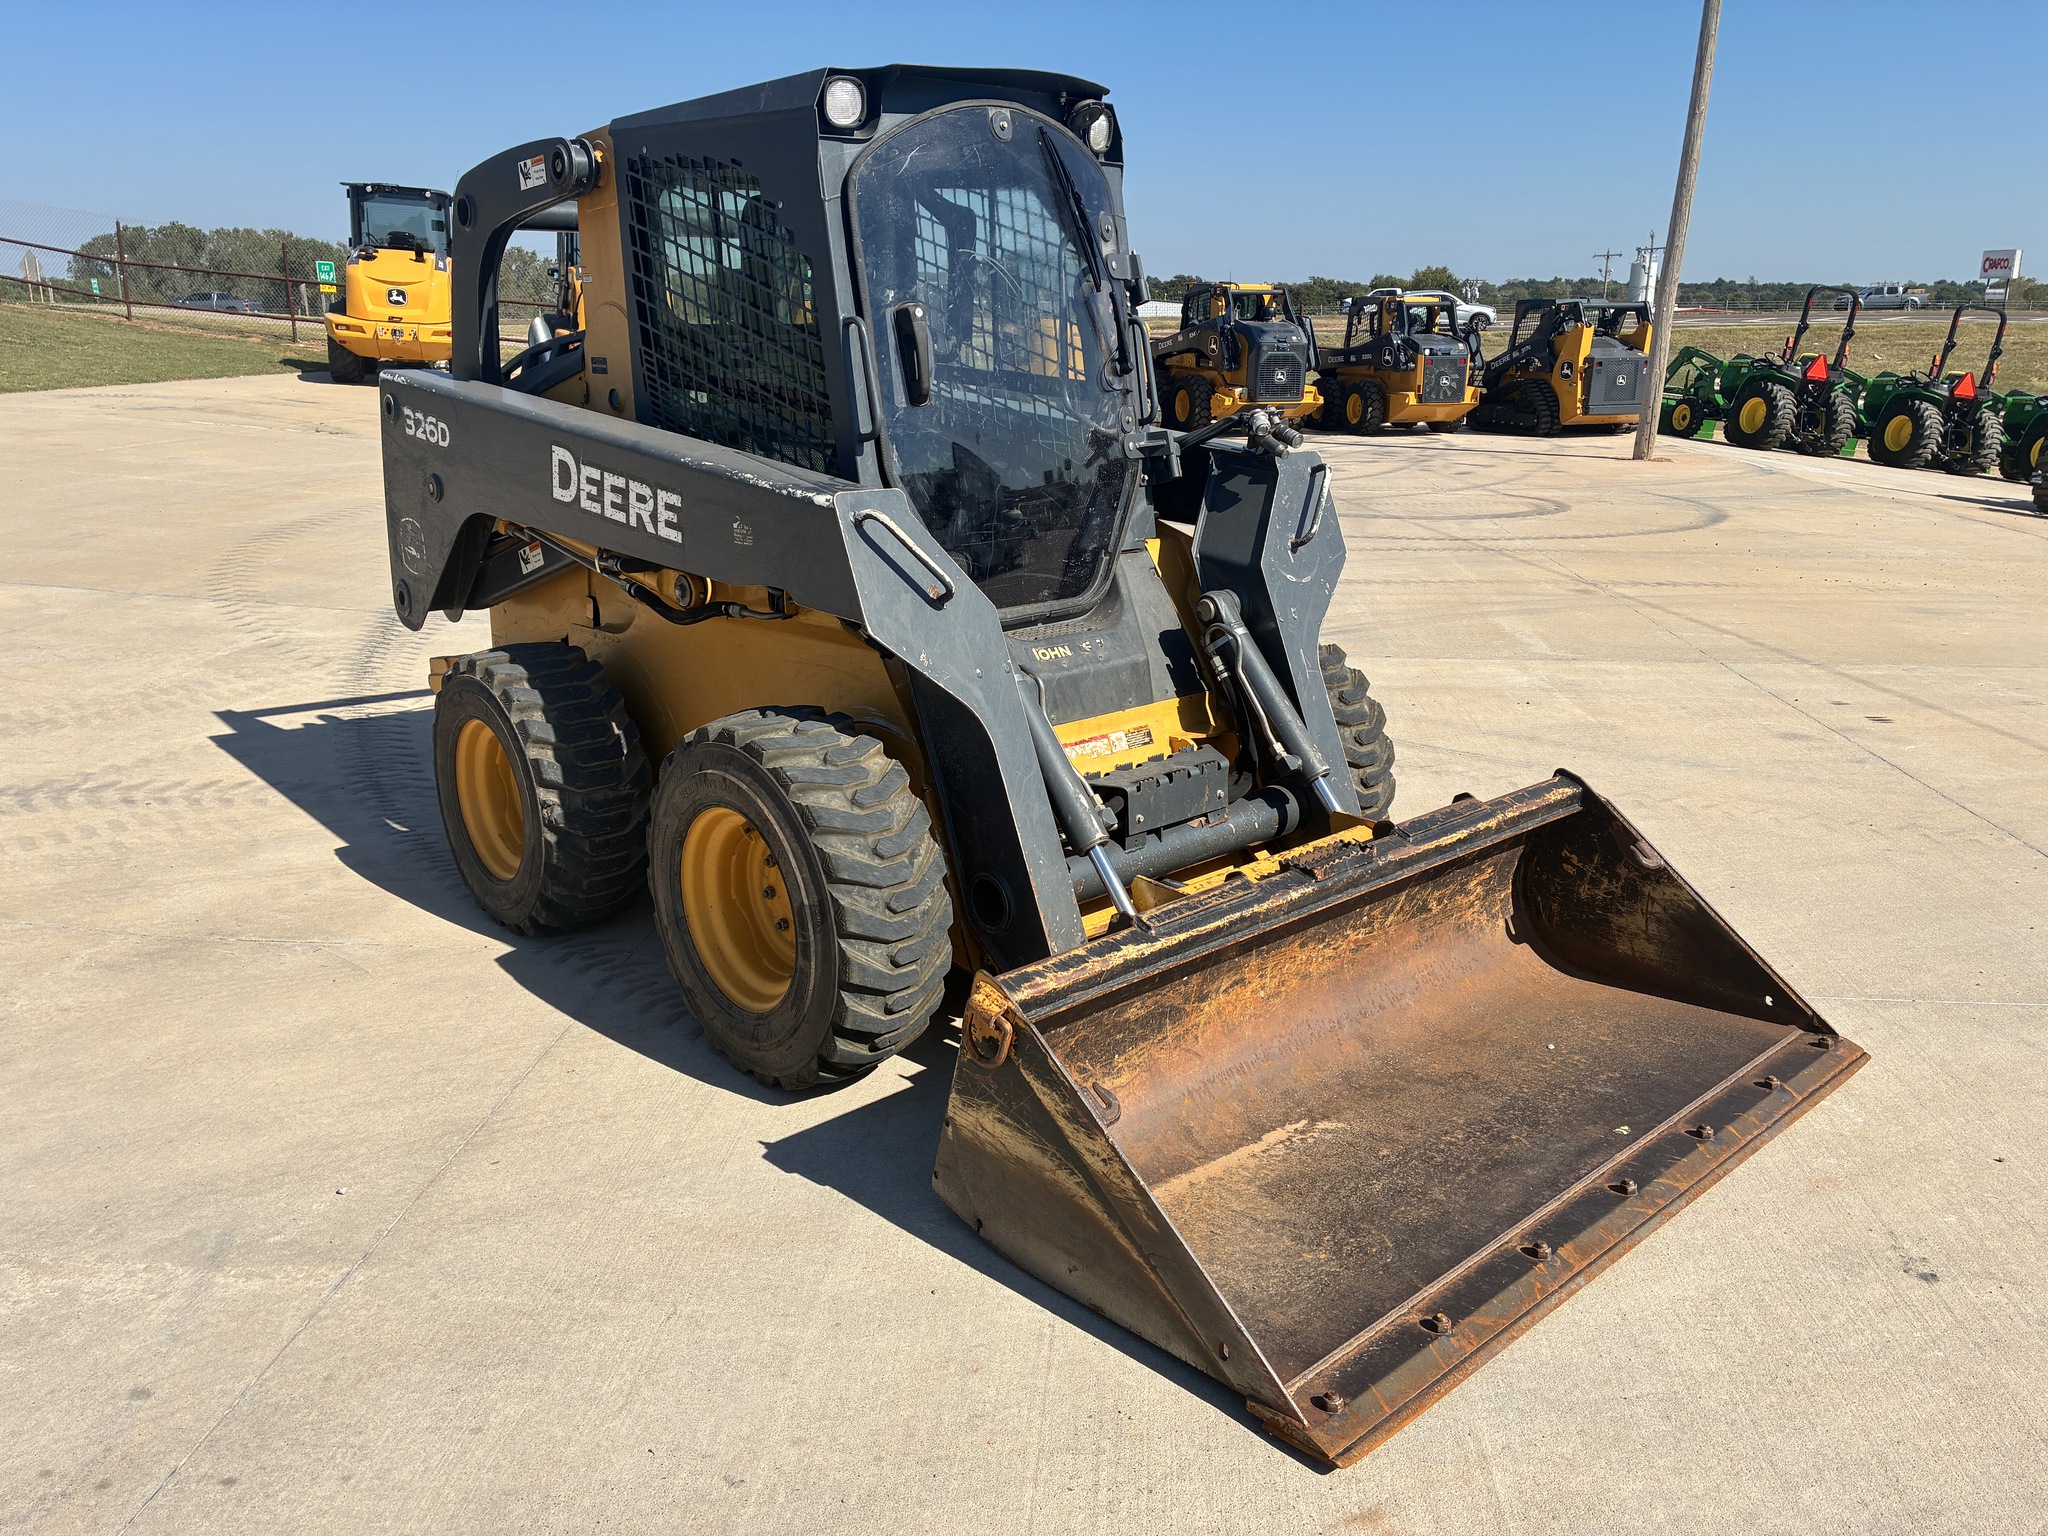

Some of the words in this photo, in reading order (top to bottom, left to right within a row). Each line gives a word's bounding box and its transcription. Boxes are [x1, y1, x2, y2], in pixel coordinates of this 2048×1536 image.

[1158, 339, 1173, 350] DEERE
[1327, 355, 1345, 364] DEERE
[1490, 353, 1511, 370] DEERE
[403, 405, 450, 448] 326D
[551, 444, 683, 543] DEERE
